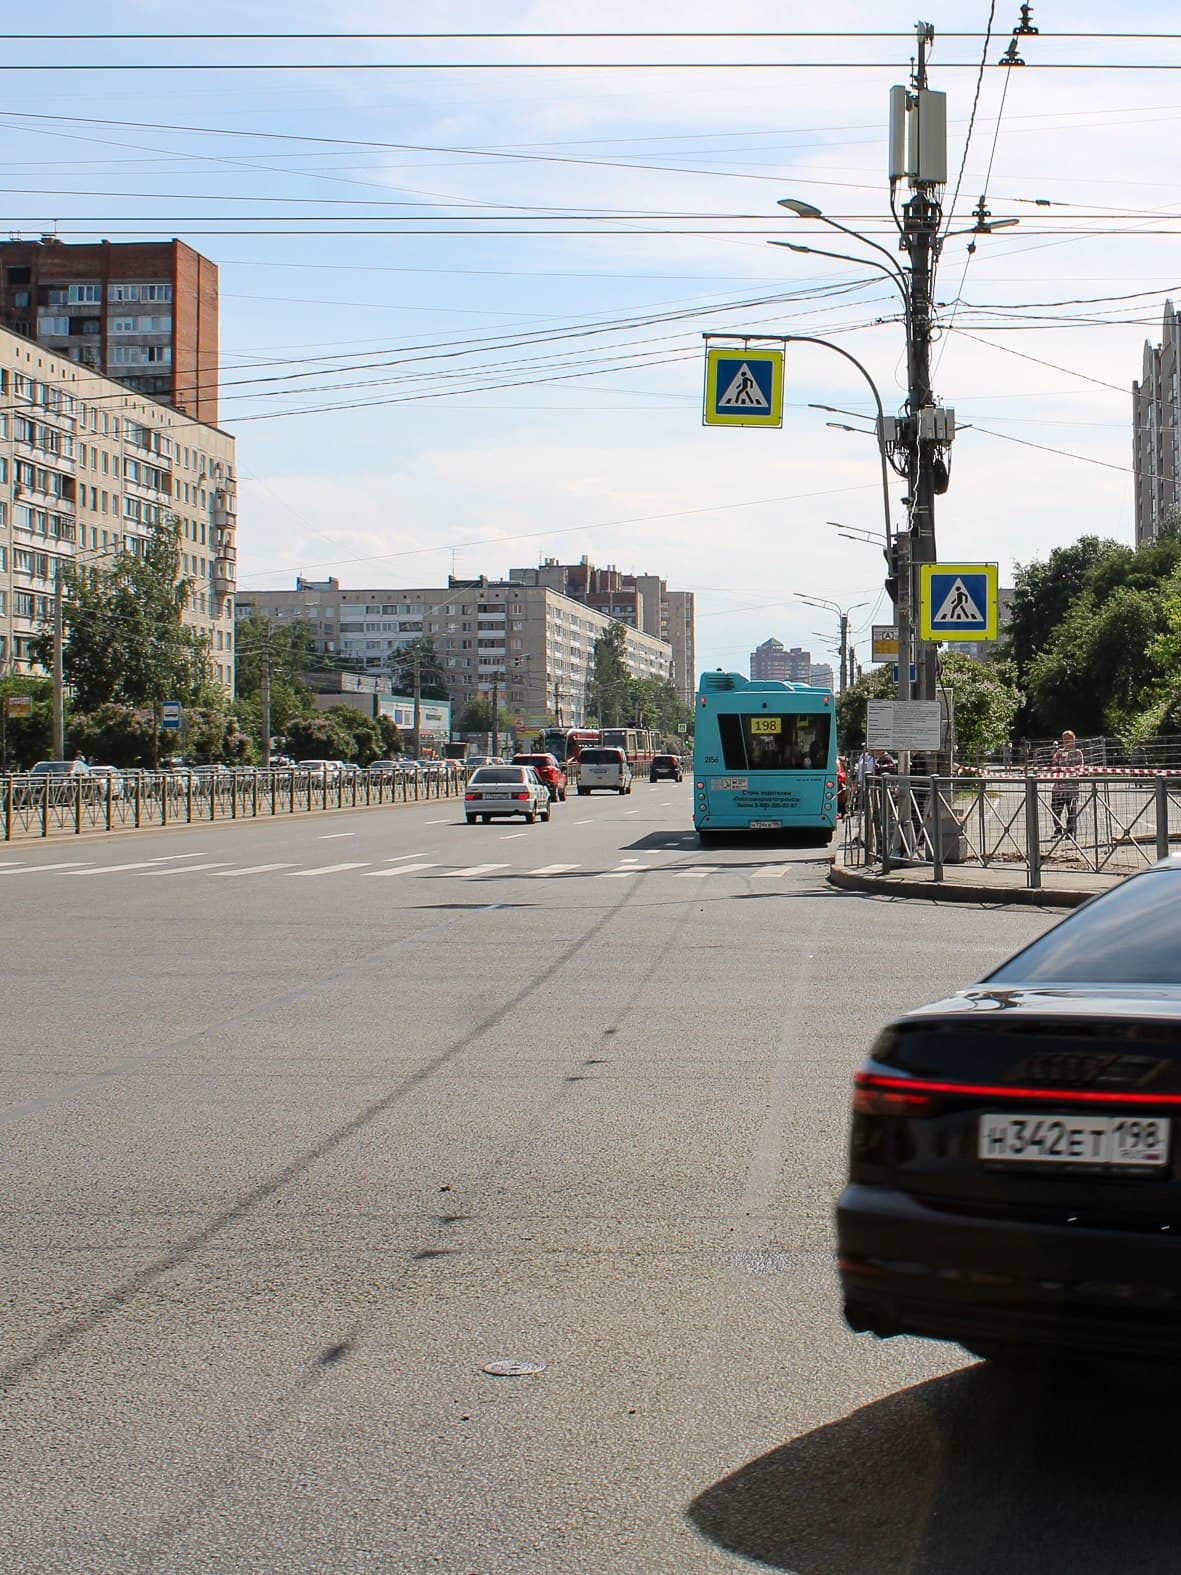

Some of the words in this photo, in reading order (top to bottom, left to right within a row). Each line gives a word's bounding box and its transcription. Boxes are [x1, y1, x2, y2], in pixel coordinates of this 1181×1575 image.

[755, 721, 777, 731] 198
[986, 1120, 1108, 1157] Н342ЕТ
[1112, 1120, 1161, 1148] 198
